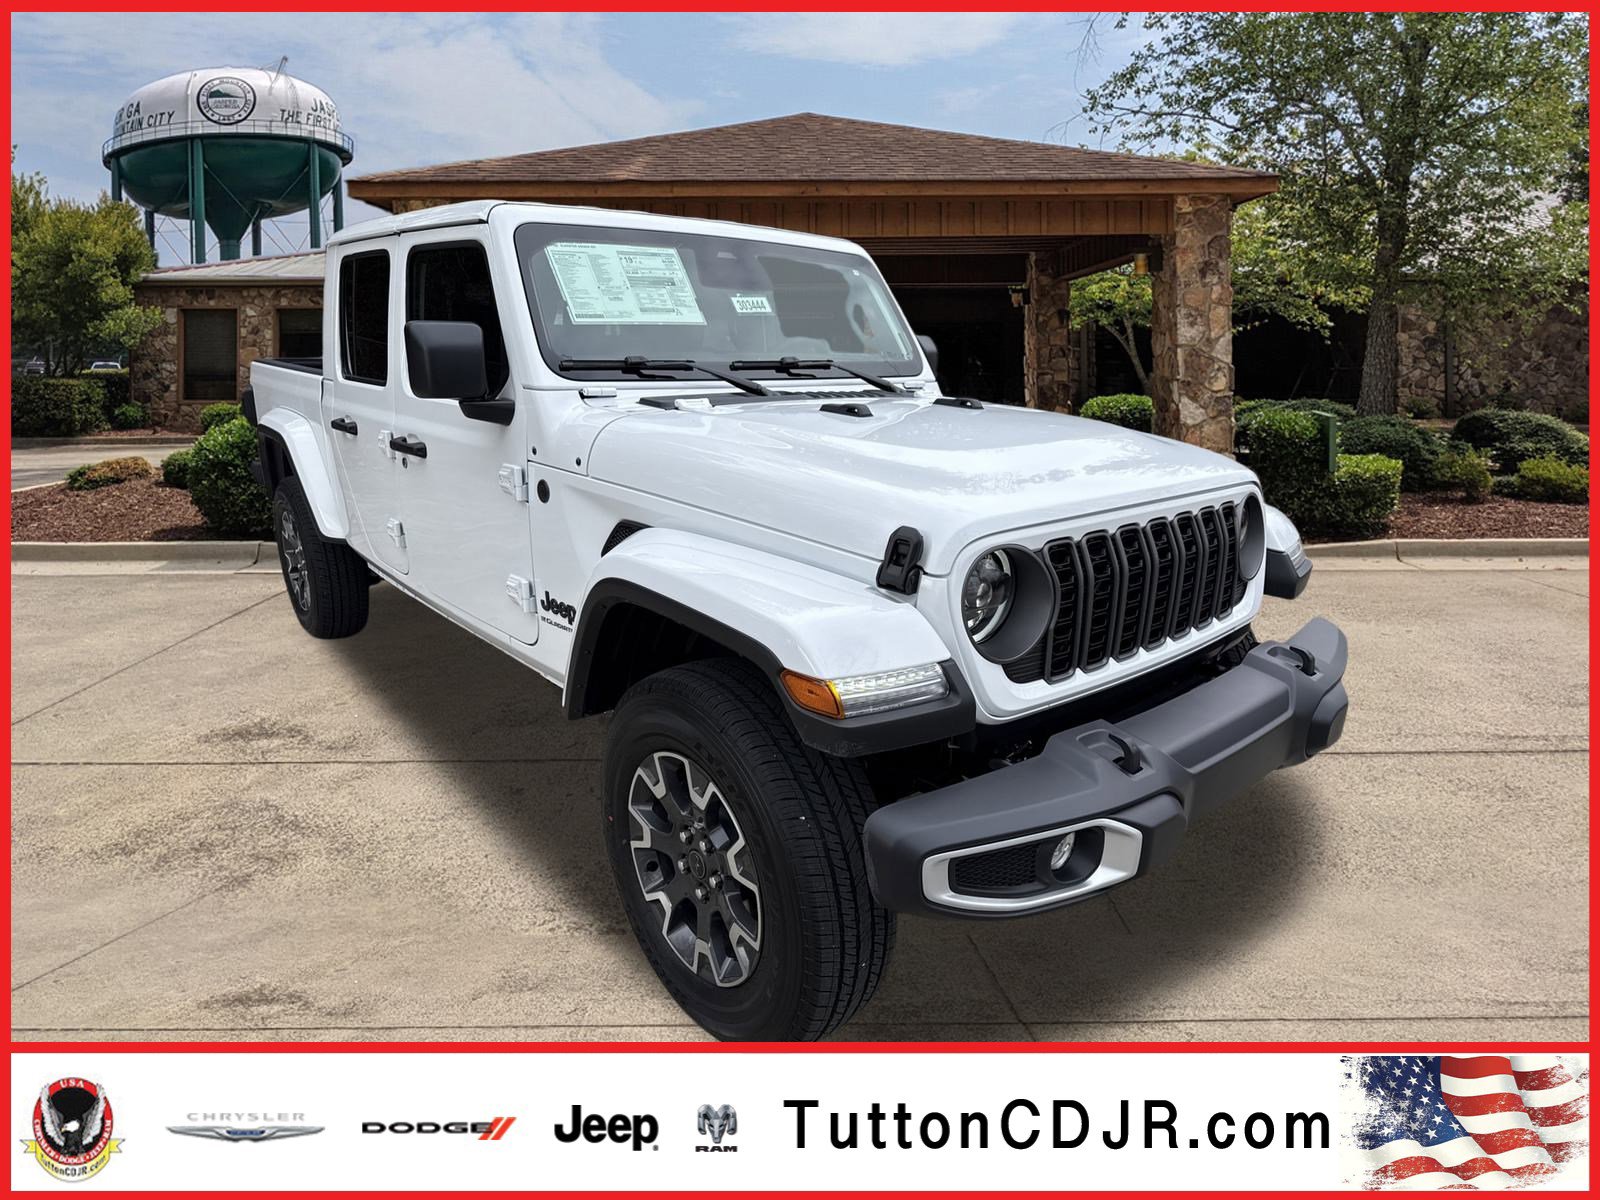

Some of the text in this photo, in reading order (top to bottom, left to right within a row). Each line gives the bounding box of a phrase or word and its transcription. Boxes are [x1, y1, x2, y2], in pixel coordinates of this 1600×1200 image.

[126, 101, 141, 119] GA
[147, 110, 175, 127] CITY
[280, 109, 302, 123] THE
[736, 299, 767, 311] 303444
[540, 591, 576, 625] Jeep
